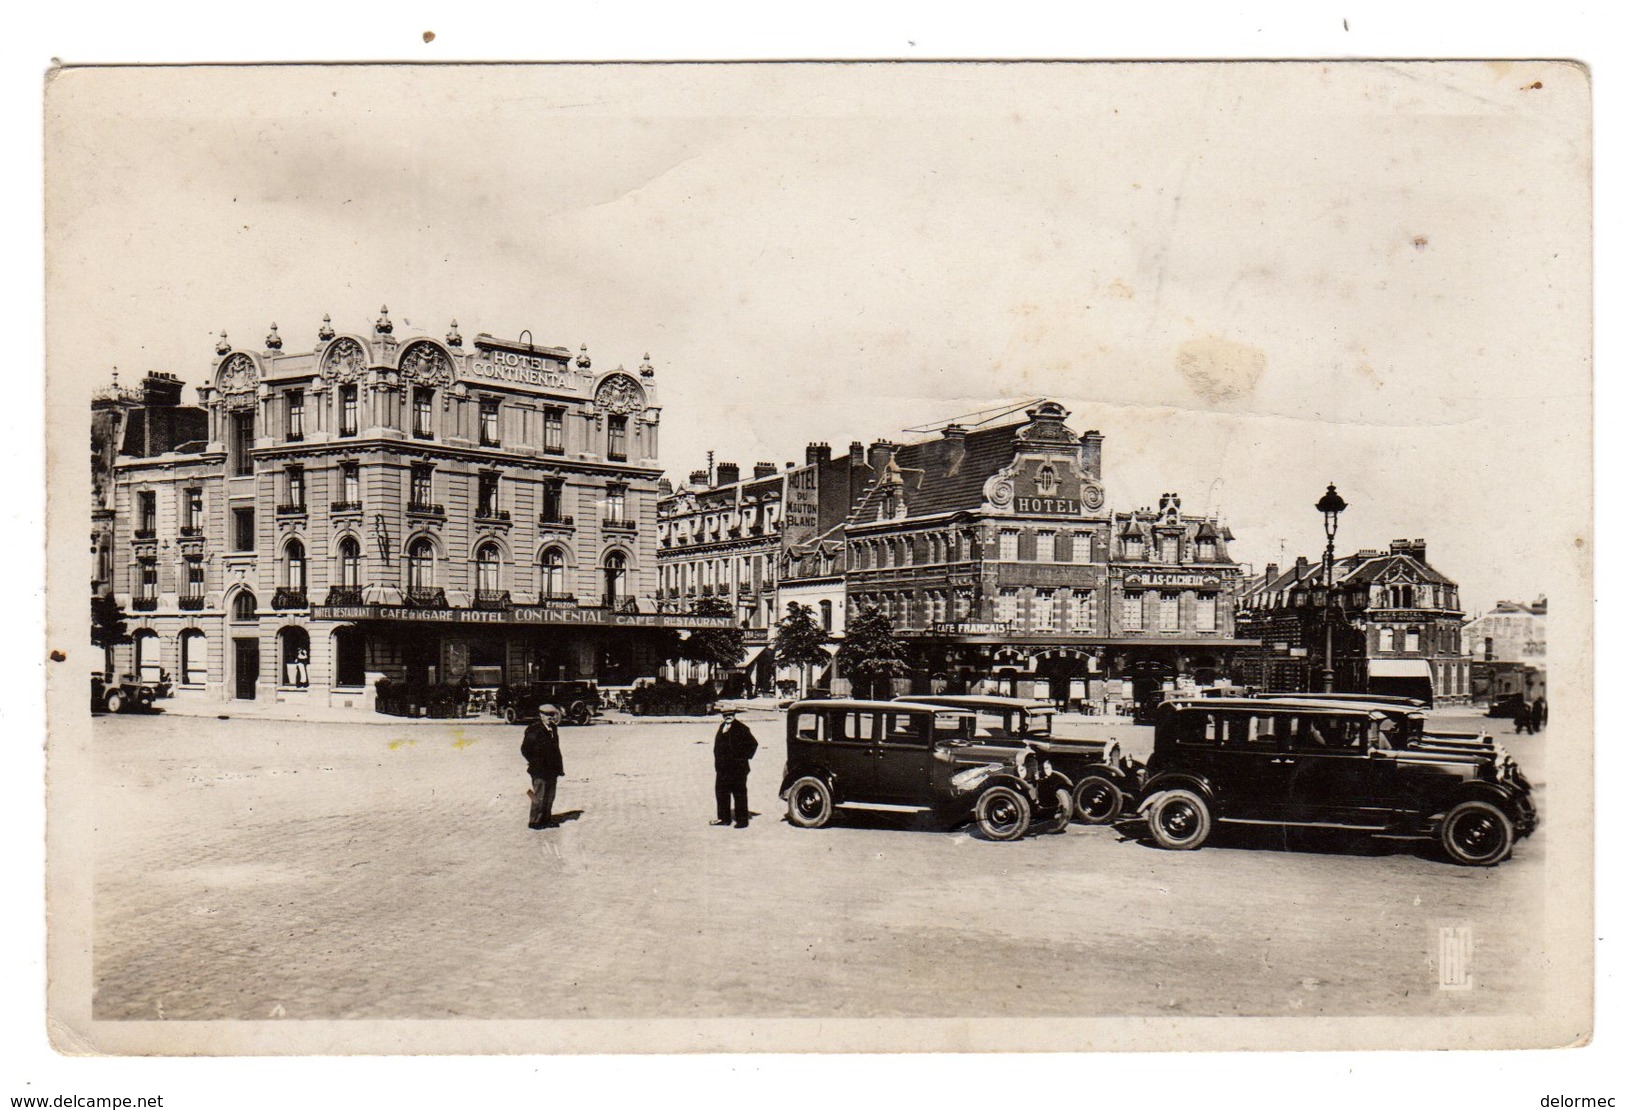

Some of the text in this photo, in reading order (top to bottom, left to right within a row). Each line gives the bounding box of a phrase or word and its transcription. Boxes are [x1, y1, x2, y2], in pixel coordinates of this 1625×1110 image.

[494, 351, 554, 373] HOTEL
[472, 362, 577, 391] CONTINENTAL
[788, 468, 816, 490] HOTEL
[797, 492, 808, 501] DU
[786, 502, 818, 514] MOUTON
[1018, 498, 1078, 513] HOTEL
[786, 515, 816, 529] BLANC
[314, 607, 370, 618] HOTEL RESTAURANT
[380, 608, 454, 621] CAFE de la GARE
[461, 608, 606, 623] HOTEL CONTINENTAL
[616, 615, 732, 627] CAFE RESTAURANT
[936, 624, 955, 633] CAFE
